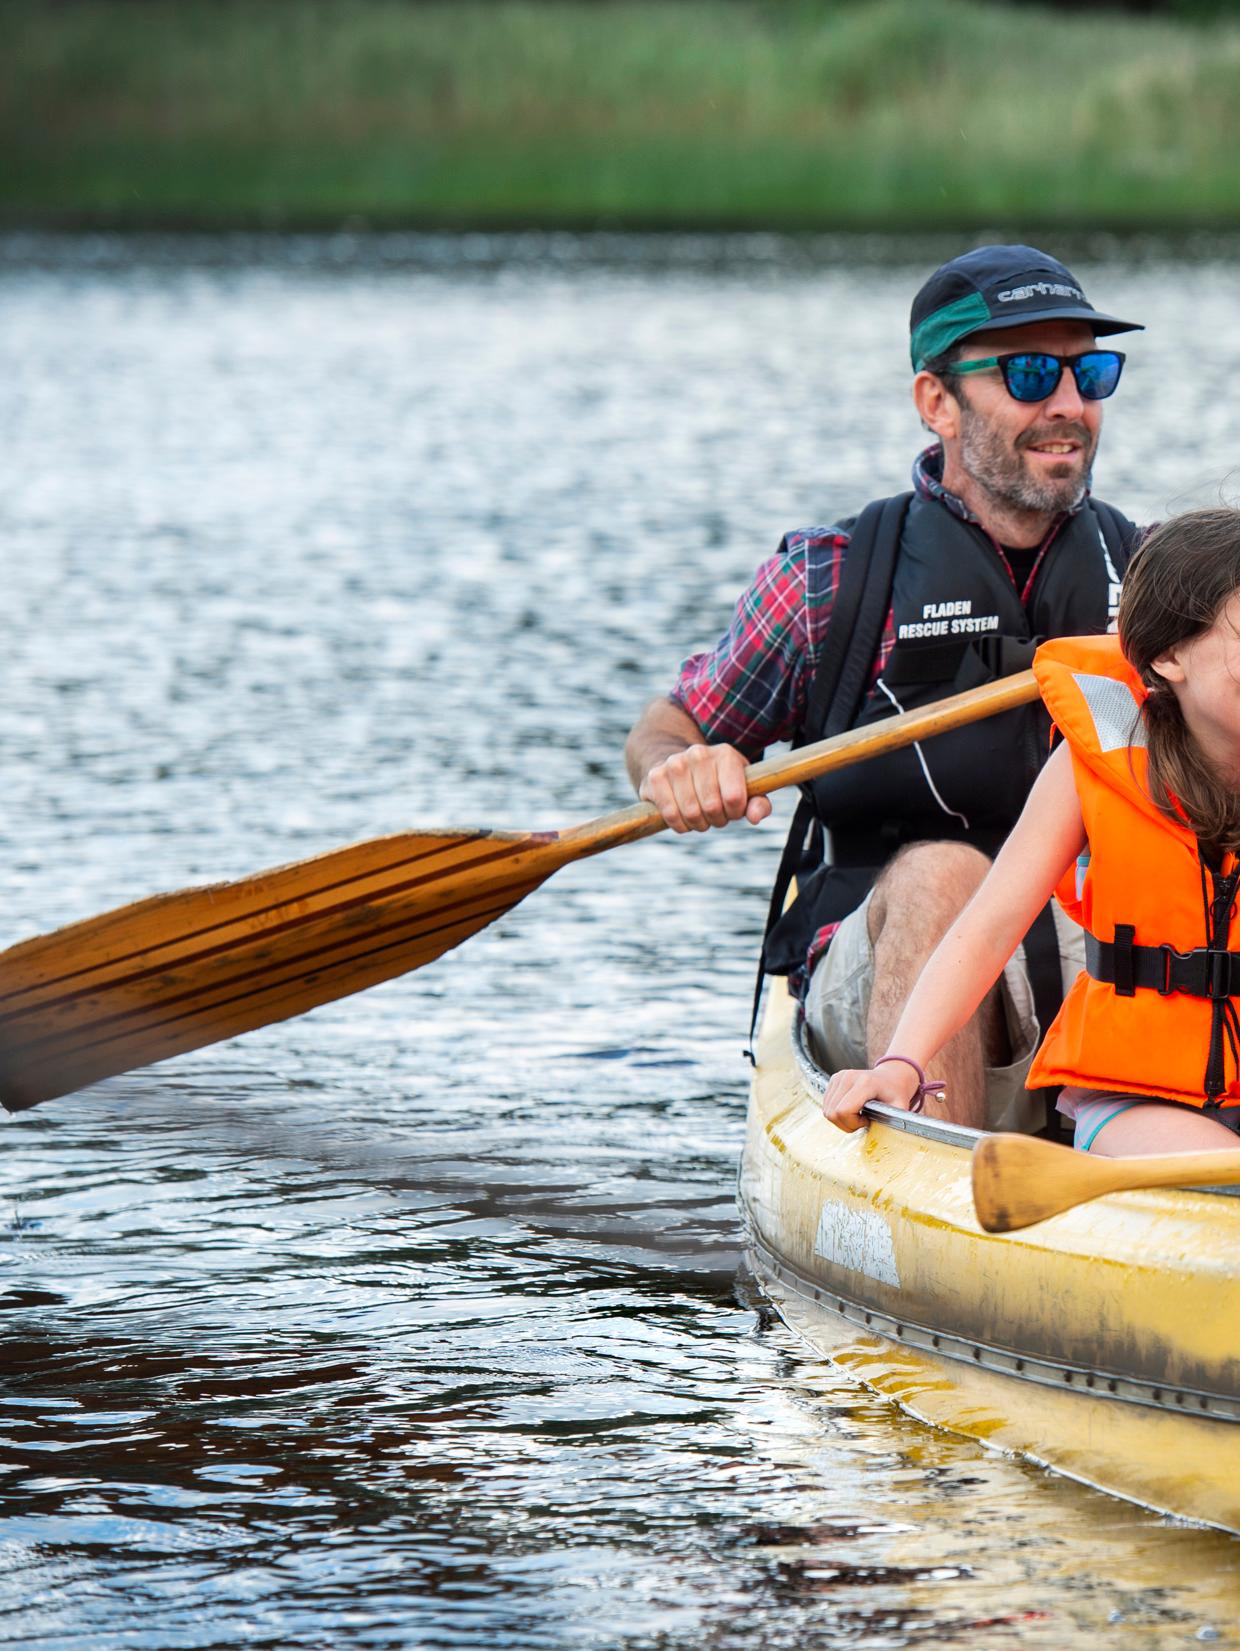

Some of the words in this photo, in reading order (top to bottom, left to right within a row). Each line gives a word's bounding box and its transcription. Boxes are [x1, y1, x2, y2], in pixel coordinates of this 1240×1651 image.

[923, 600, 972, 619] FLADEN
[899, 620, 949, 639] RESCUE
[951, 616, 999, 634] SYSTEM
